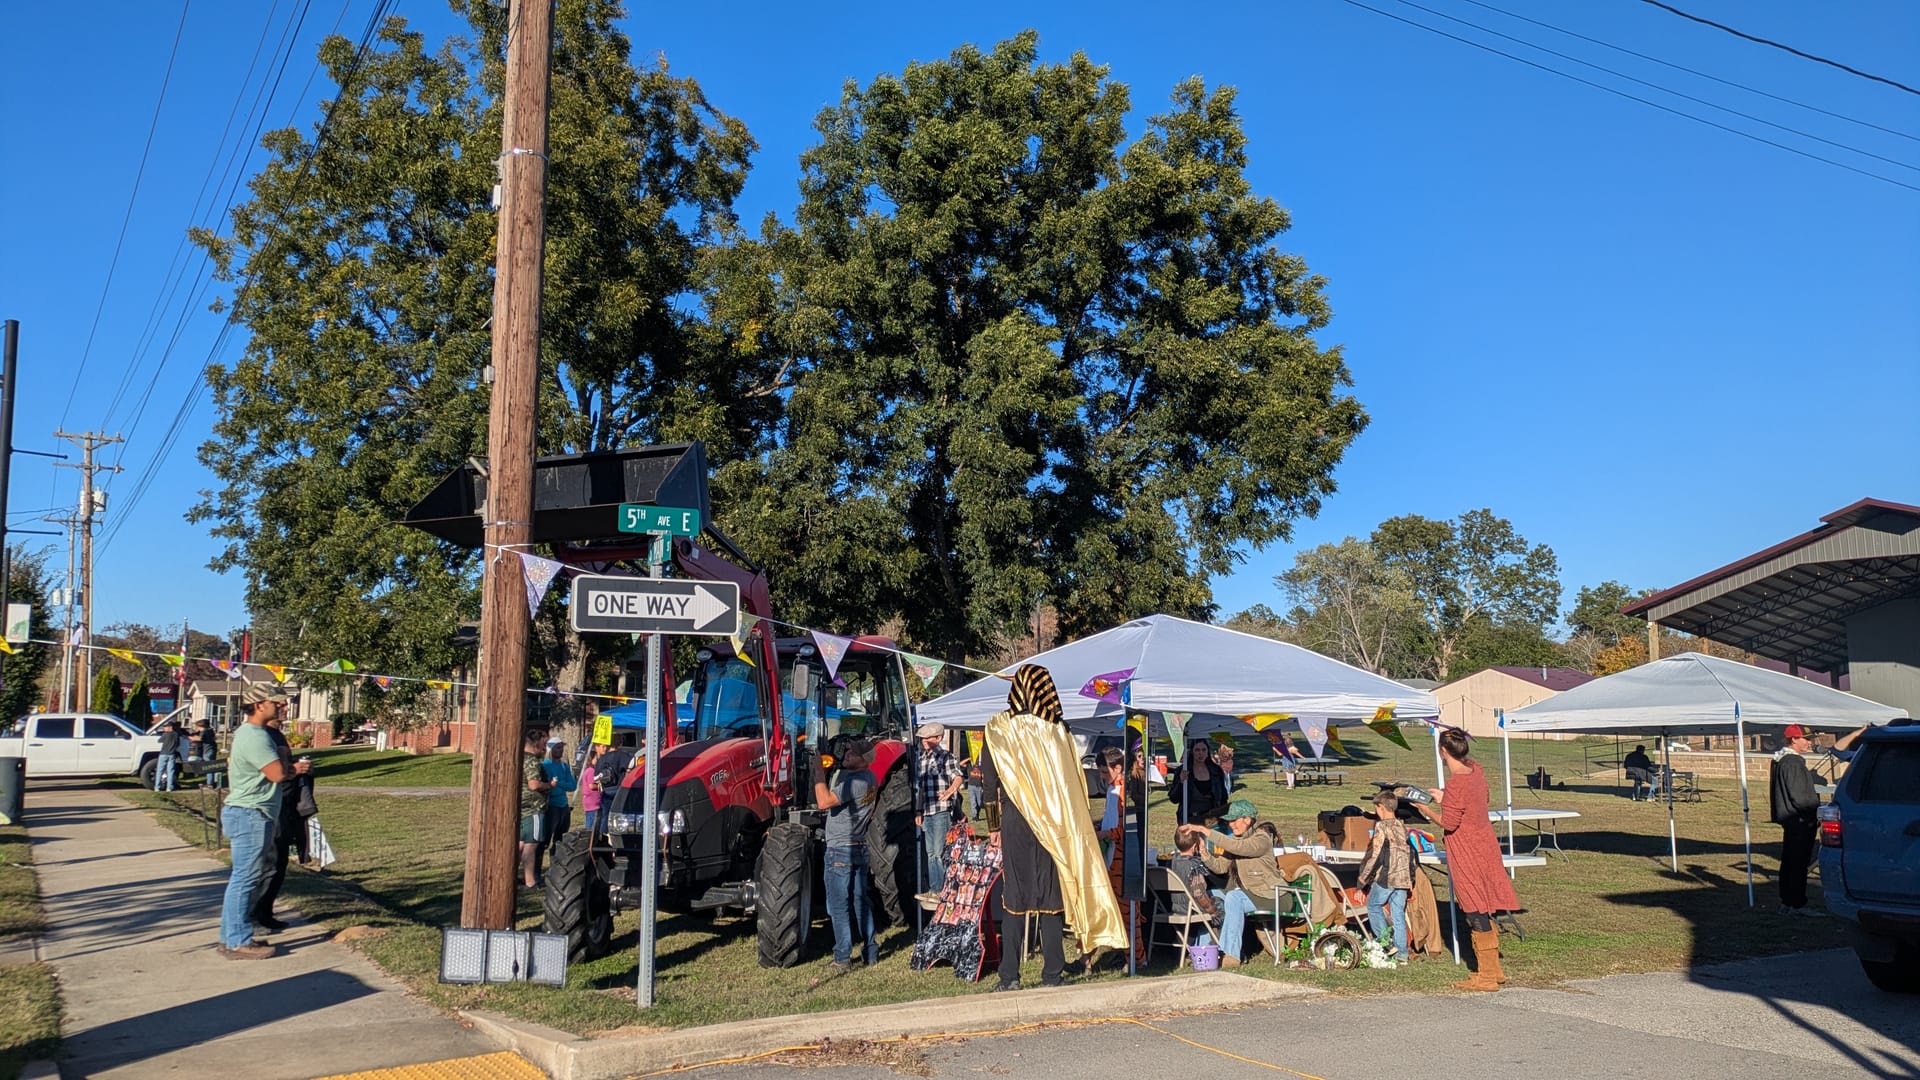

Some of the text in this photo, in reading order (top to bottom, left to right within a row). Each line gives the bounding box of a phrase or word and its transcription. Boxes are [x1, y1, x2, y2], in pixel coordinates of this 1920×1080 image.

[628, 509, 691, 532] 5TH AVE E
[595, 594, 690, 616] ONE WAY
